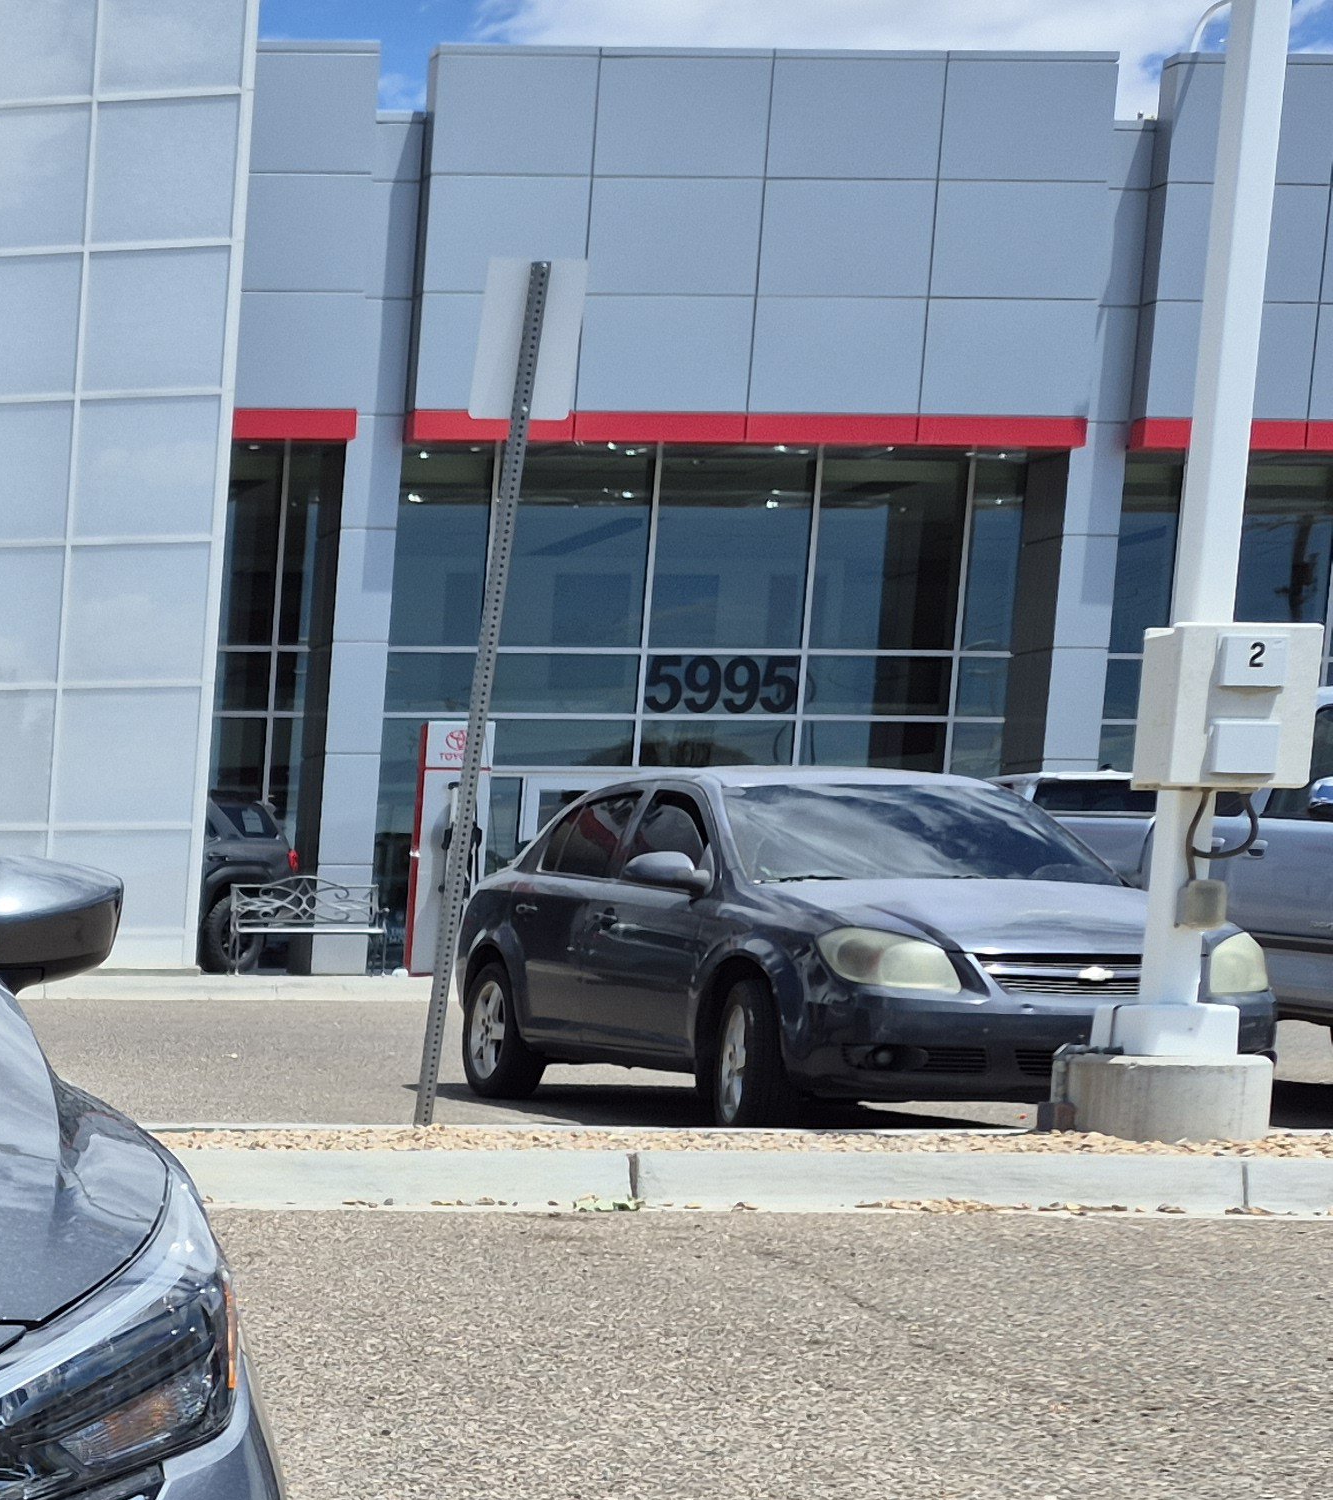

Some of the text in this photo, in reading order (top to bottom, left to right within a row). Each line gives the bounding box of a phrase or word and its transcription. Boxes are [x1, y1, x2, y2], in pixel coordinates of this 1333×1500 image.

[1248, 641, 1266, 668] 2
[644, 654, 799, 714] 5995
[439, 752, 464, 761] TOY
